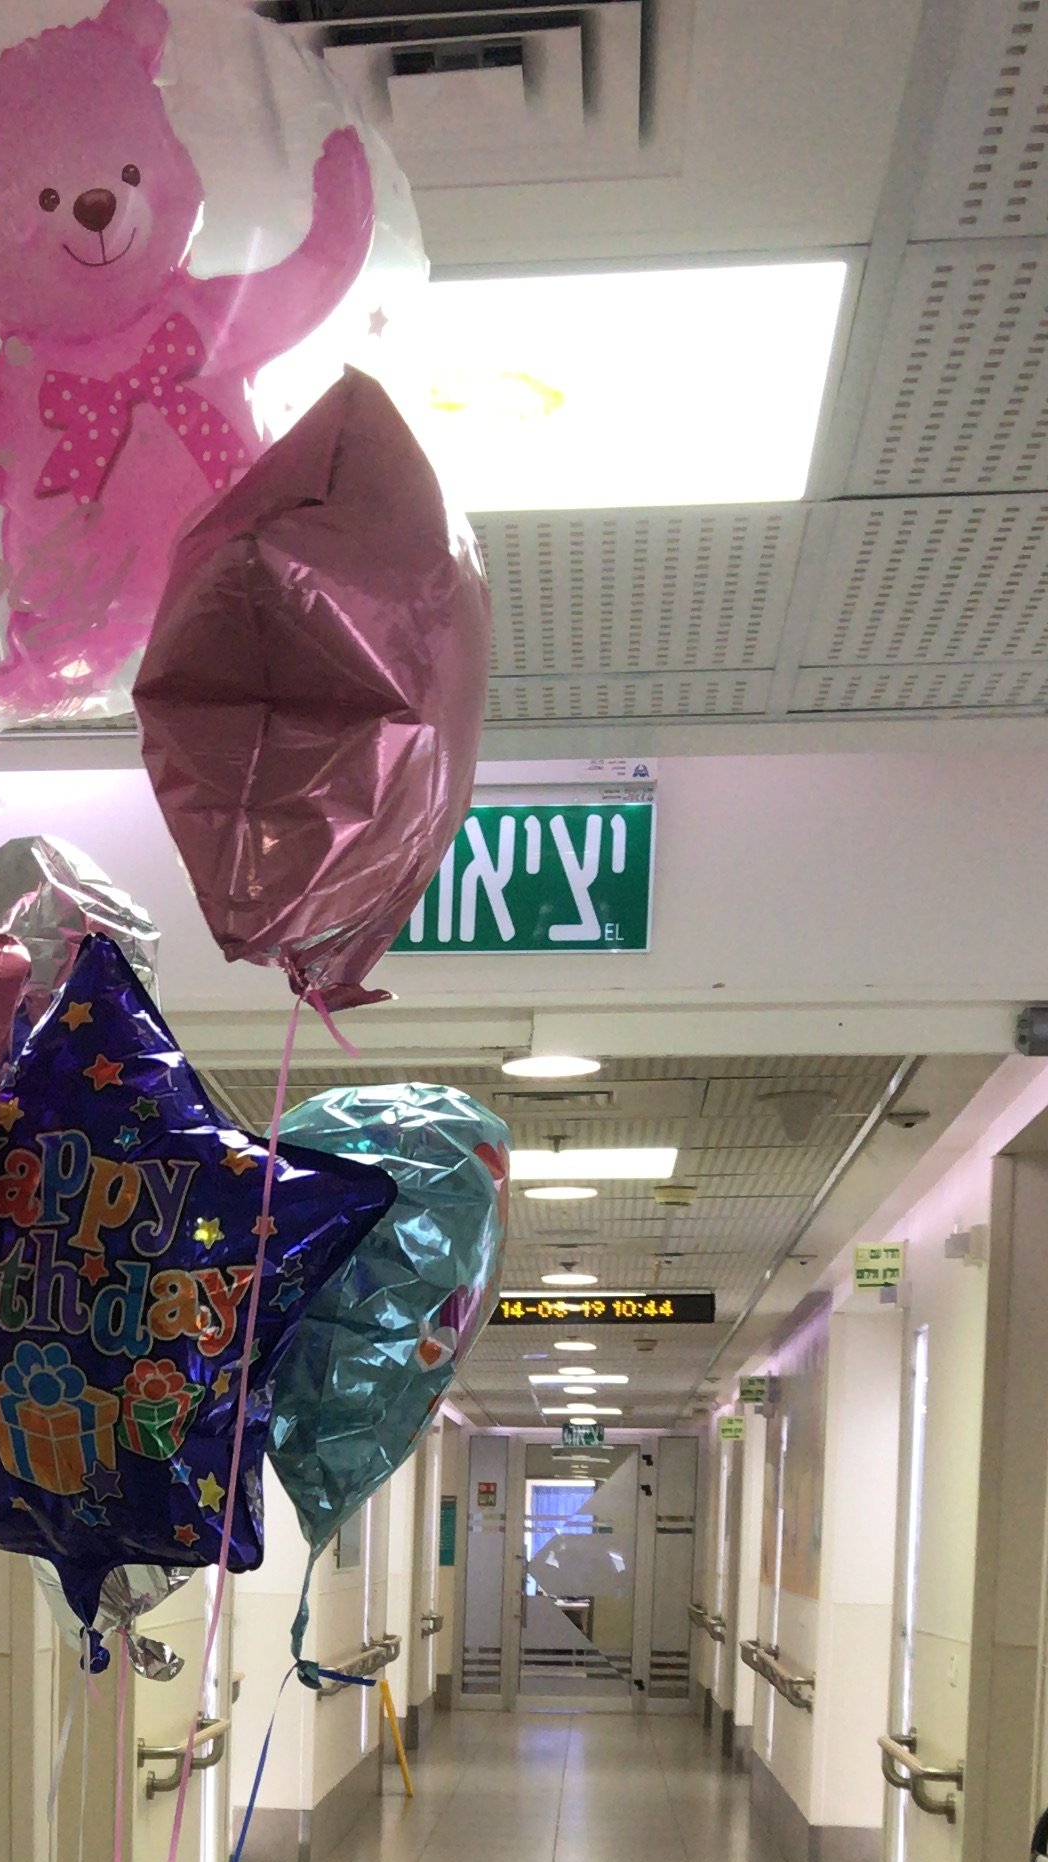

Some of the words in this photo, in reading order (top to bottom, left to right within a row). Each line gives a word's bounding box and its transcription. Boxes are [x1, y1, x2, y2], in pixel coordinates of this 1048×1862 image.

[409, 814, 627, 943] יציאו
[604, 923, 625, 941] EL
[612, 1299, 674, 1318] 10:44
